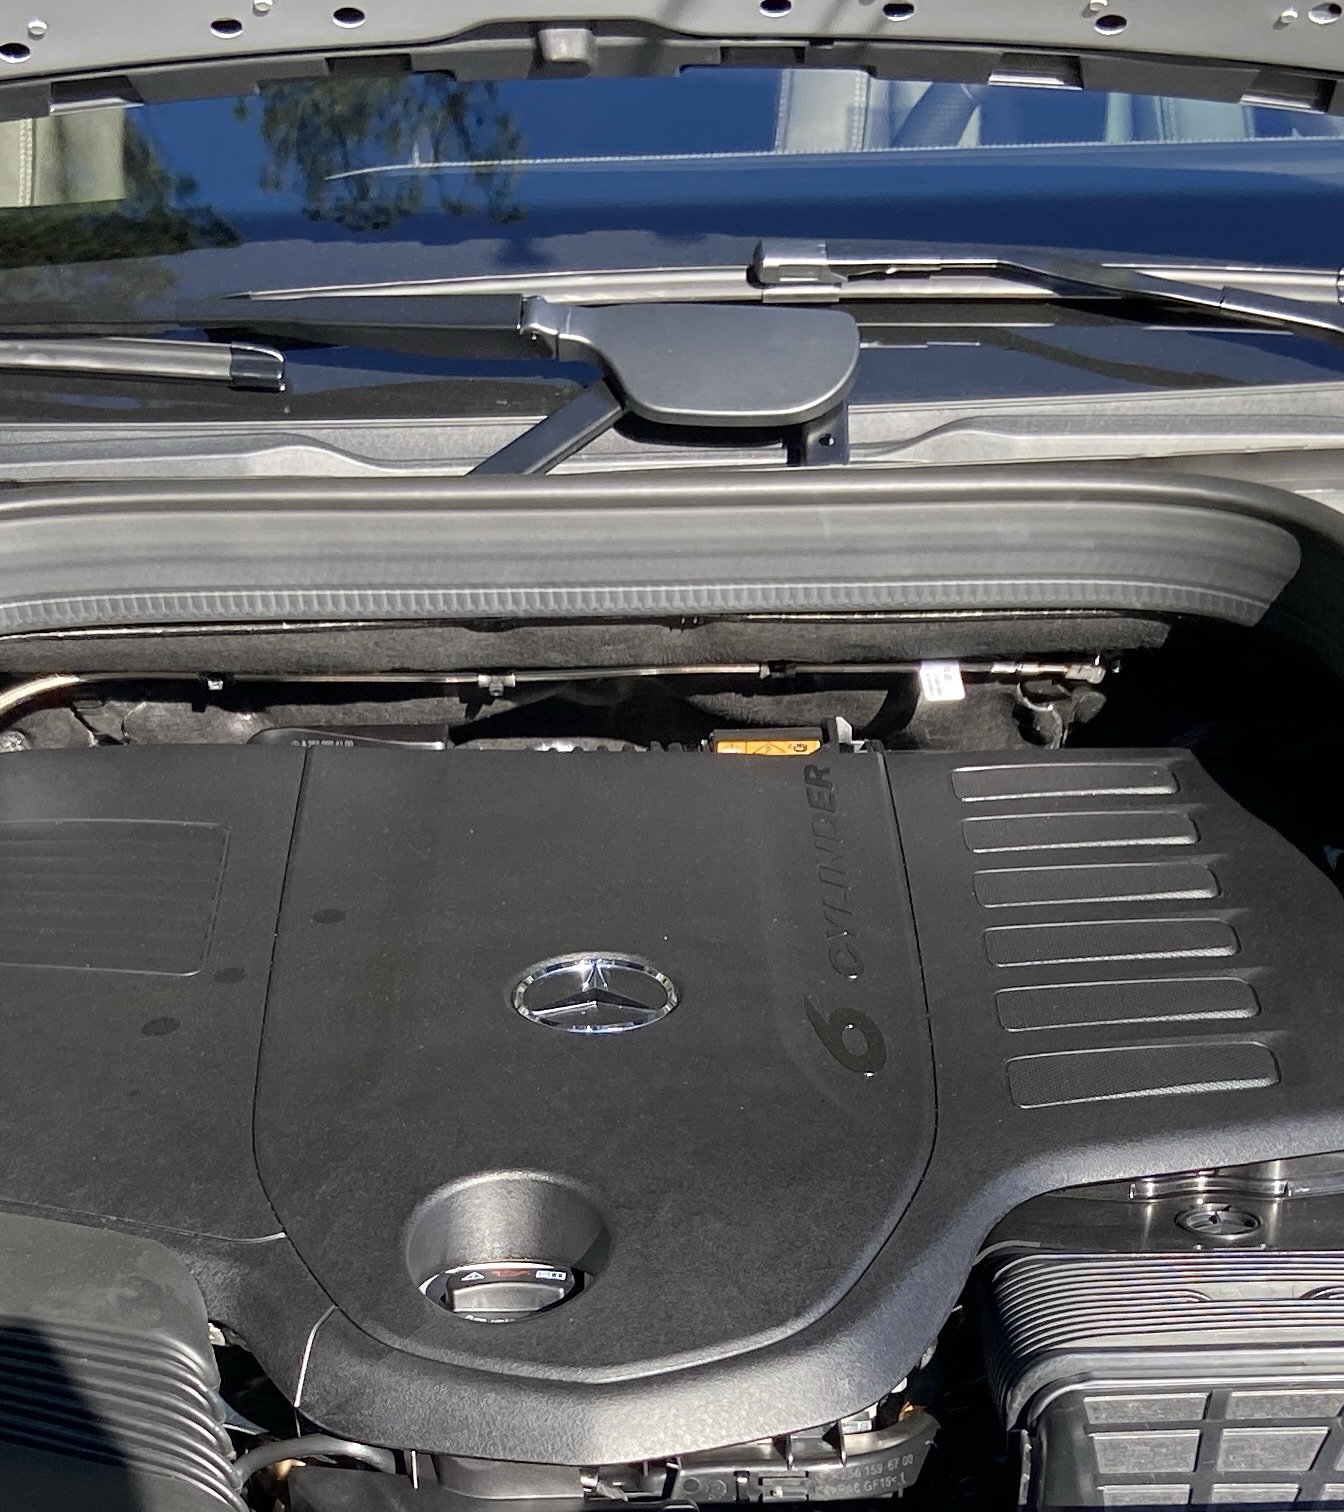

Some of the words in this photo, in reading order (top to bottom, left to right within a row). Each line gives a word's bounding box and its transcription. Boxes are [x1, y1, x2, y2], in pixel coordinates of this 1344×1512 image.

[804, 763, 865, 979] CYLINDER
[803, 993, 887, 1074] 6
[864, 1463, 883, 1476] 159
